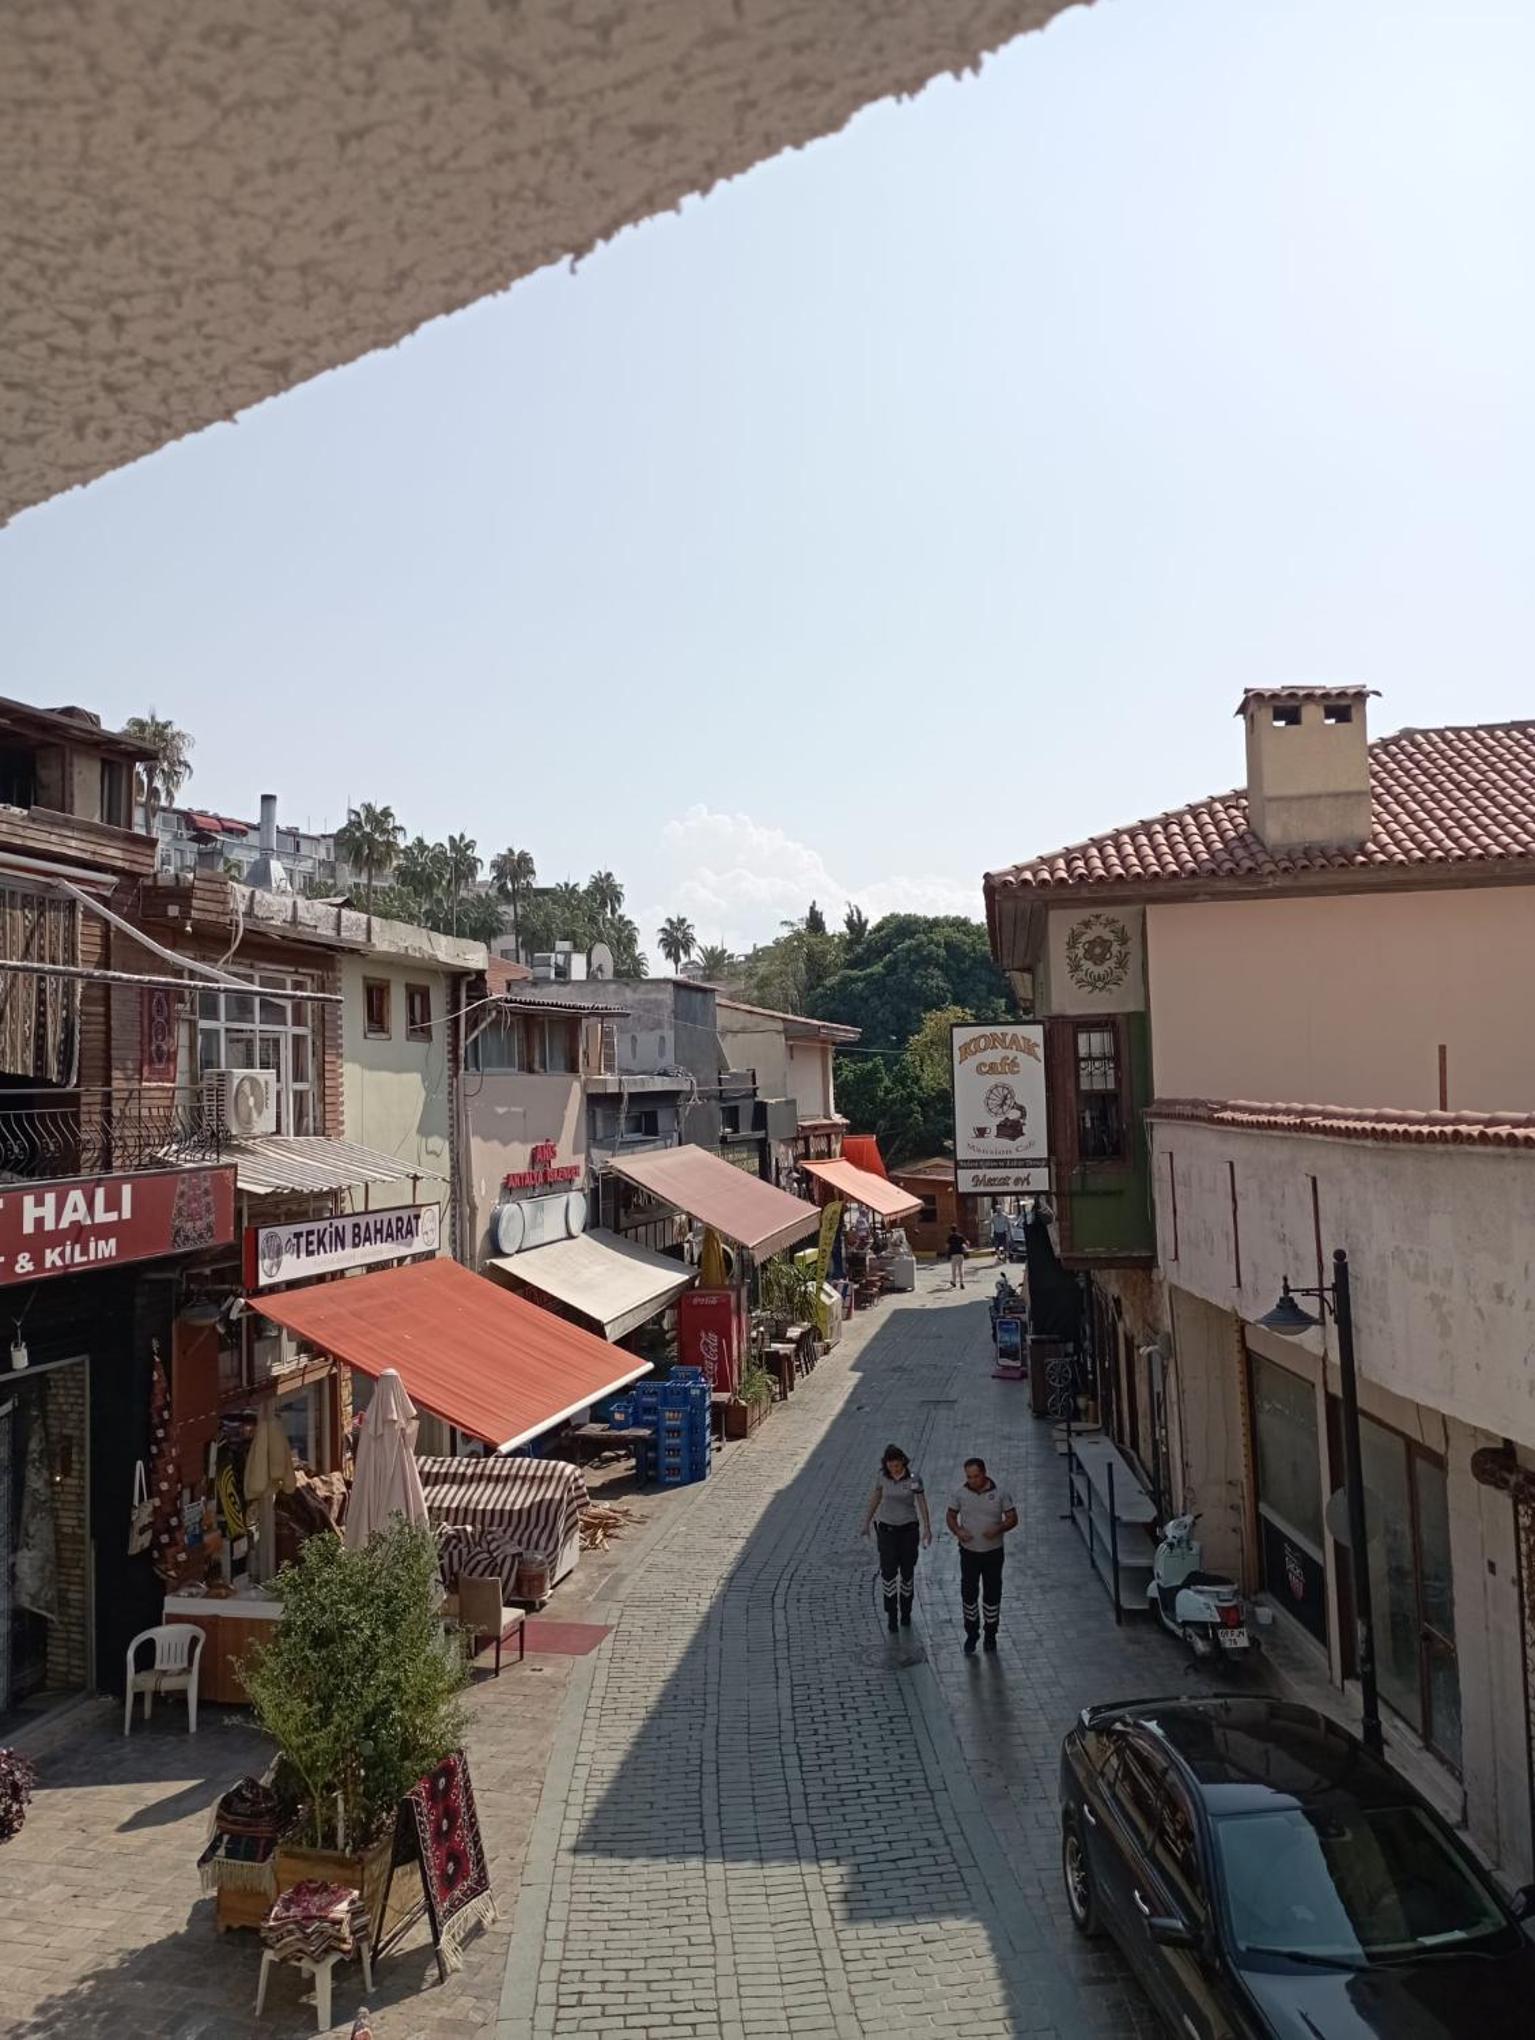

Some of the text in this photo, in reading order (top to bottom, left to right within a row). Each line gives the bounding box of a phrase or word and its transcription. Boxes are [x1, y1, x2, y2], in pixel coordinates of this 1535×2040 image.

[958, 1031, 1042, 1065] KONAK
[23, 1183, 132, 1235] HALI
[14, 1236, 117, 1274] & KİLİM
[293, 1221, 346, 1260] TEKİN
[352, 1213, 421, 1249] BAHARAT
